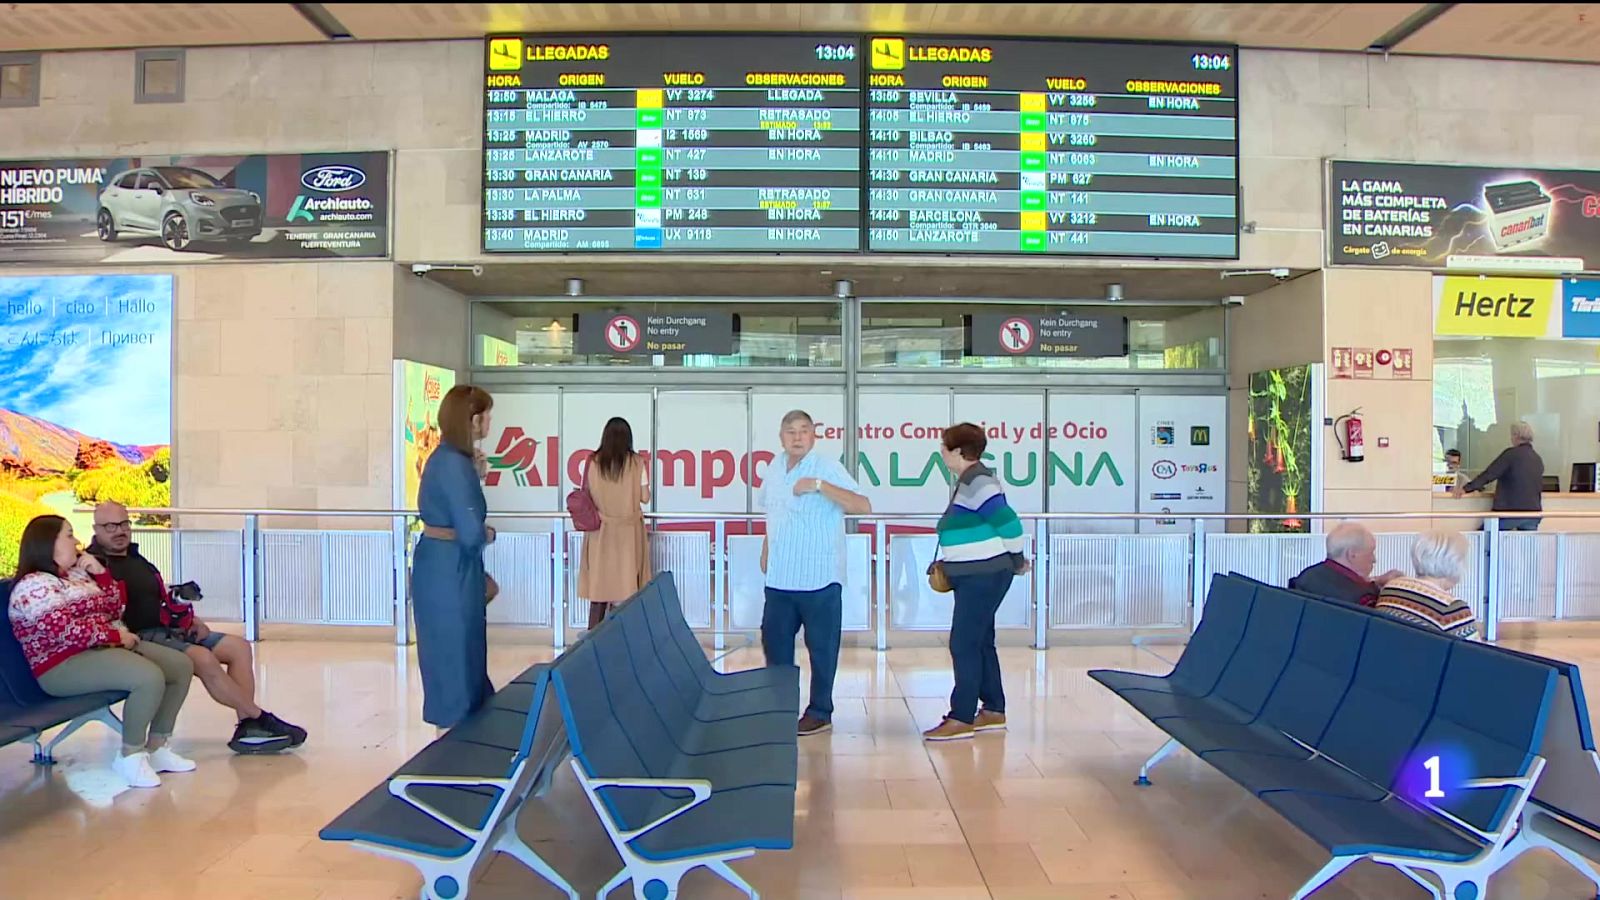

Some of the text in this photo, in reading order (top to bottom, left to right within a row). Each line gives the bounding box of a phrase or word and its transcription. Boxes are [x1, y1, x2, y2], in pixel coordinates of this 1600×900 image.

[526, 46, 609, 60] LLEGADAS
[815, 45, 855, 60] 13:04
[909, 47, 992, 62] LLEGADAS
[1192, 55, 1229, 69] 13:04
[488, 74, 845, 86] HORA ORIGEN VUELO OBSERVACIONES
[870, 75, 1221, 94] HORA ORIGEN VUELO OBSERVACIONES
[526, 91, 575, 102] MALAGA
[666, 90, 682, 100] VY
[688, 90, 713, 100] 3274
[768, 90, 822, 101] LLEGADA
[910, 92, 956, 102] SEVILLA
[1049, 95, 1066, 105] VY
[1149, 98, 1165, 108] EN
[1168, 98, 1199, 109] HORA
[526, 111, 540, 121] EL
[542, 111, 586, 121] HIERRO
[666, 110, 682, 120] NT
[759, 110, 830, 120] RETRASADO
[910, 112, 923, 122] EL
[926, 112, 970, 122] HIERRO
[1049, 114, 1065, 124] NT
[526, 131, 569, 141] MADRID
[769, 130, 785, 140] EN
[788, 130, 821, 140] HORA
[870, 131, 898, 141] 14:10
[909, 132, 952, 142] BILBAO
[1049, 134, 1065, 144] VY
[525, 150, 593, 160] LANZAROTE
[665, 150, 681, 160] NT
[687, 150, 706, 160] 427
[769, 150, 785, 160] EN
[788, 150, 821, 160] HORA
[870, 151, 898, 161] 14:10
[909, 152, 954, 162] MADRID
[1049, 154, 1065, 163] NT
[1149, 156, 1165, 166] EN
[1168, 157, 1199, 167] HORA
[1, 170, 54, 185] NUEVO
[313, 170, 352, 187] Ford
[525, 170, 557, 180] GRAN
[561, 170, 612, 180] CANARIA
[665, 170, 681, 180] NT
[687, 170, 706, 180] 139
[909, 172, 942, 182] GRAN
[946, 172, 997, 182] CANARIA
[1049, 174, 1066, 184] PM
[1072, 174, 1091, 184] 627
[1, 182, 62, 204] HÍBRIDO
[1342, 181, 1402, 193] LA GAMA
[525, 190, 539, 200] LA
[542, 190, 581, 200] PALMA
[665, 190, 681, 200] NT
[687, 190, 705, 200] 631
[759, 190, 830, 199] RETRASADO
[909, 192, 942, 202] GRAN
[946, 192, 997, 202] CANARIA
[1049, 193, 1065, 203] NT
[1070, 193, 1088, 203] 141
[1342, 193, 1447, 209] MÁS COMPLETA
[524, 210, 538, 220] EL
[542, 210, 584, 220] HIERRO
[665, 210, 682, 220] PM
[689, 210, 707, 220] 248
[768, 210, 784, 219] EN
[787, 210, 820, 220] HORA
[870, 210, 898, 220] 14:40
[909, 211, 981, 222] BARCELONA
[1049, 213, 1065, 223] VY
[1070, 213, 1095, 224] 3212
[1149, 215, 1165, 225] EN
[1168, 215, 1199, 226] HORA
[1343, 207, 1429, 222] DE BATERÍAS
[1343, 224, 1432, 237] EN CANARIAS
[1501, 214, 1545, 237] canaribat
[486, 230, 513, 240] 13:40
[524, 230, 568, 240] MADRID
[665, 230, 681, 239] UX
[687, 230, 711, 240] 9118
[768, 229, 784, 240] EN
[787, 229, 820, 240] HORA
[909, 231, 978, 241] LANZAROTE
[1049, 233, 1066, 243] NT
[1071, 233, 1088, 243] 441
[8, 299, 155, 315] hello ciao Hallo
[1455, 292, 1534, 318] Hertz
[666, 317, 706, 325] Durchgang
[1059, 319, 1097, 328] Durchgang
[660, 328, 679, 336] entry
[1053, 330, 1072, 338] entry
[102, 331, 154, 347] Привет
[662, 343, 685, 351] pasar
[1055, 345, 1078, 353] pasar
[1013, 426, 1025, 443] y
[1030, 423, 1057, 439] de
[1067, 422, 1107, 439] Ocio
